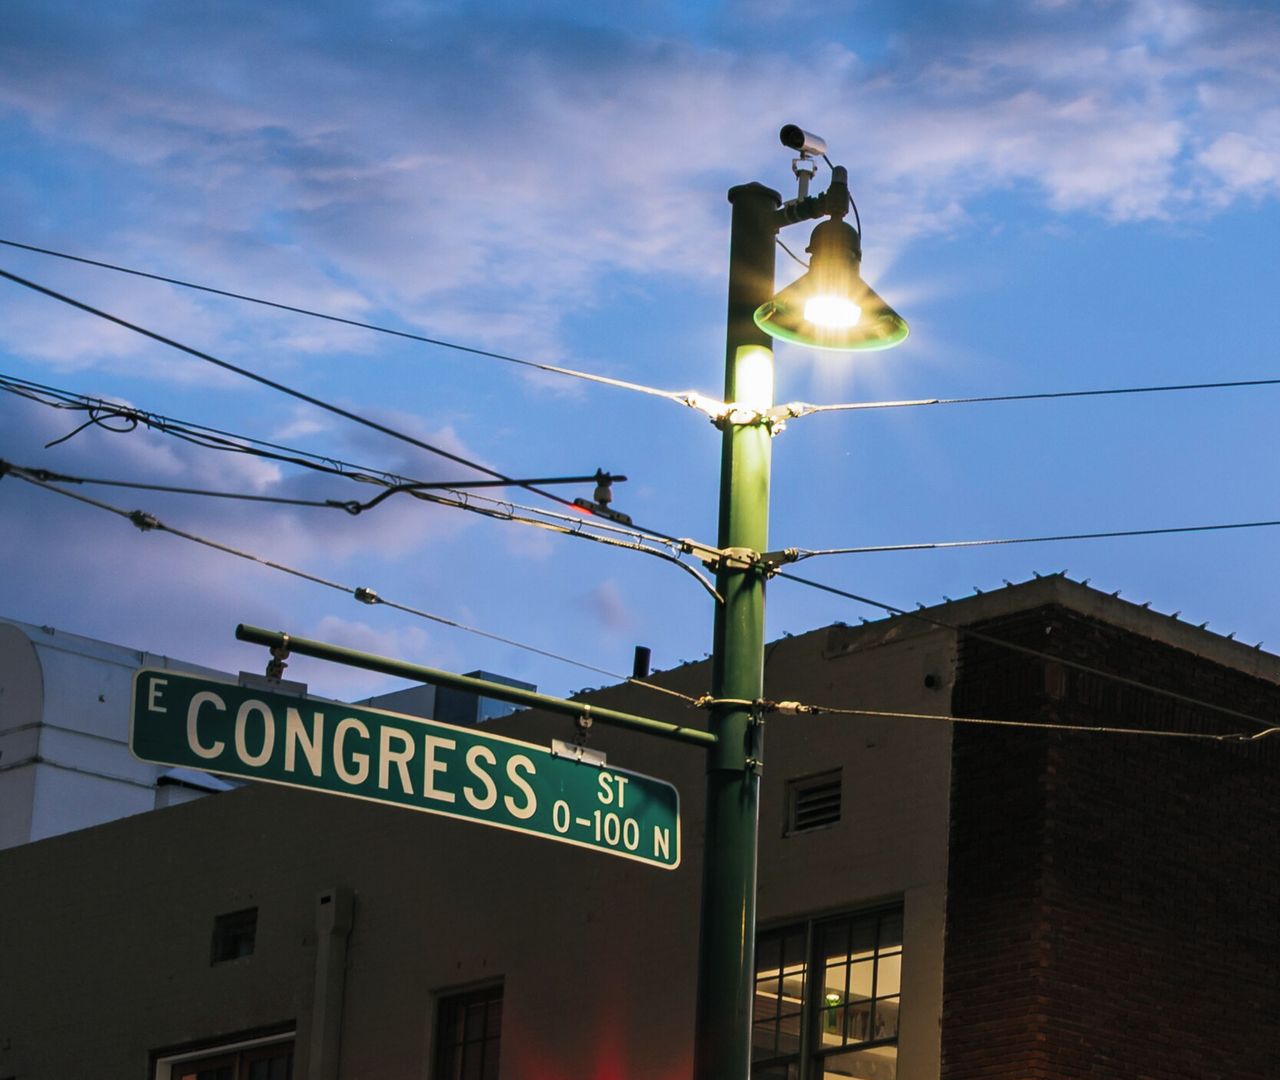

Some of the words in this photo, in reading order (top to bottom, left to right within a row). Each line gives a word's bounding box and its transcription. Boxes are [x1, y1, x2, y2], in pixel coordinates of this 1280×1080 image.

[147, 679, 168, 714] E
[186, 691, 537, 820] CONGRESS
[597, 772, 629, 809] ST
[552, 801, 639, 851] 0-100
[653, 827, 670, 860] N
